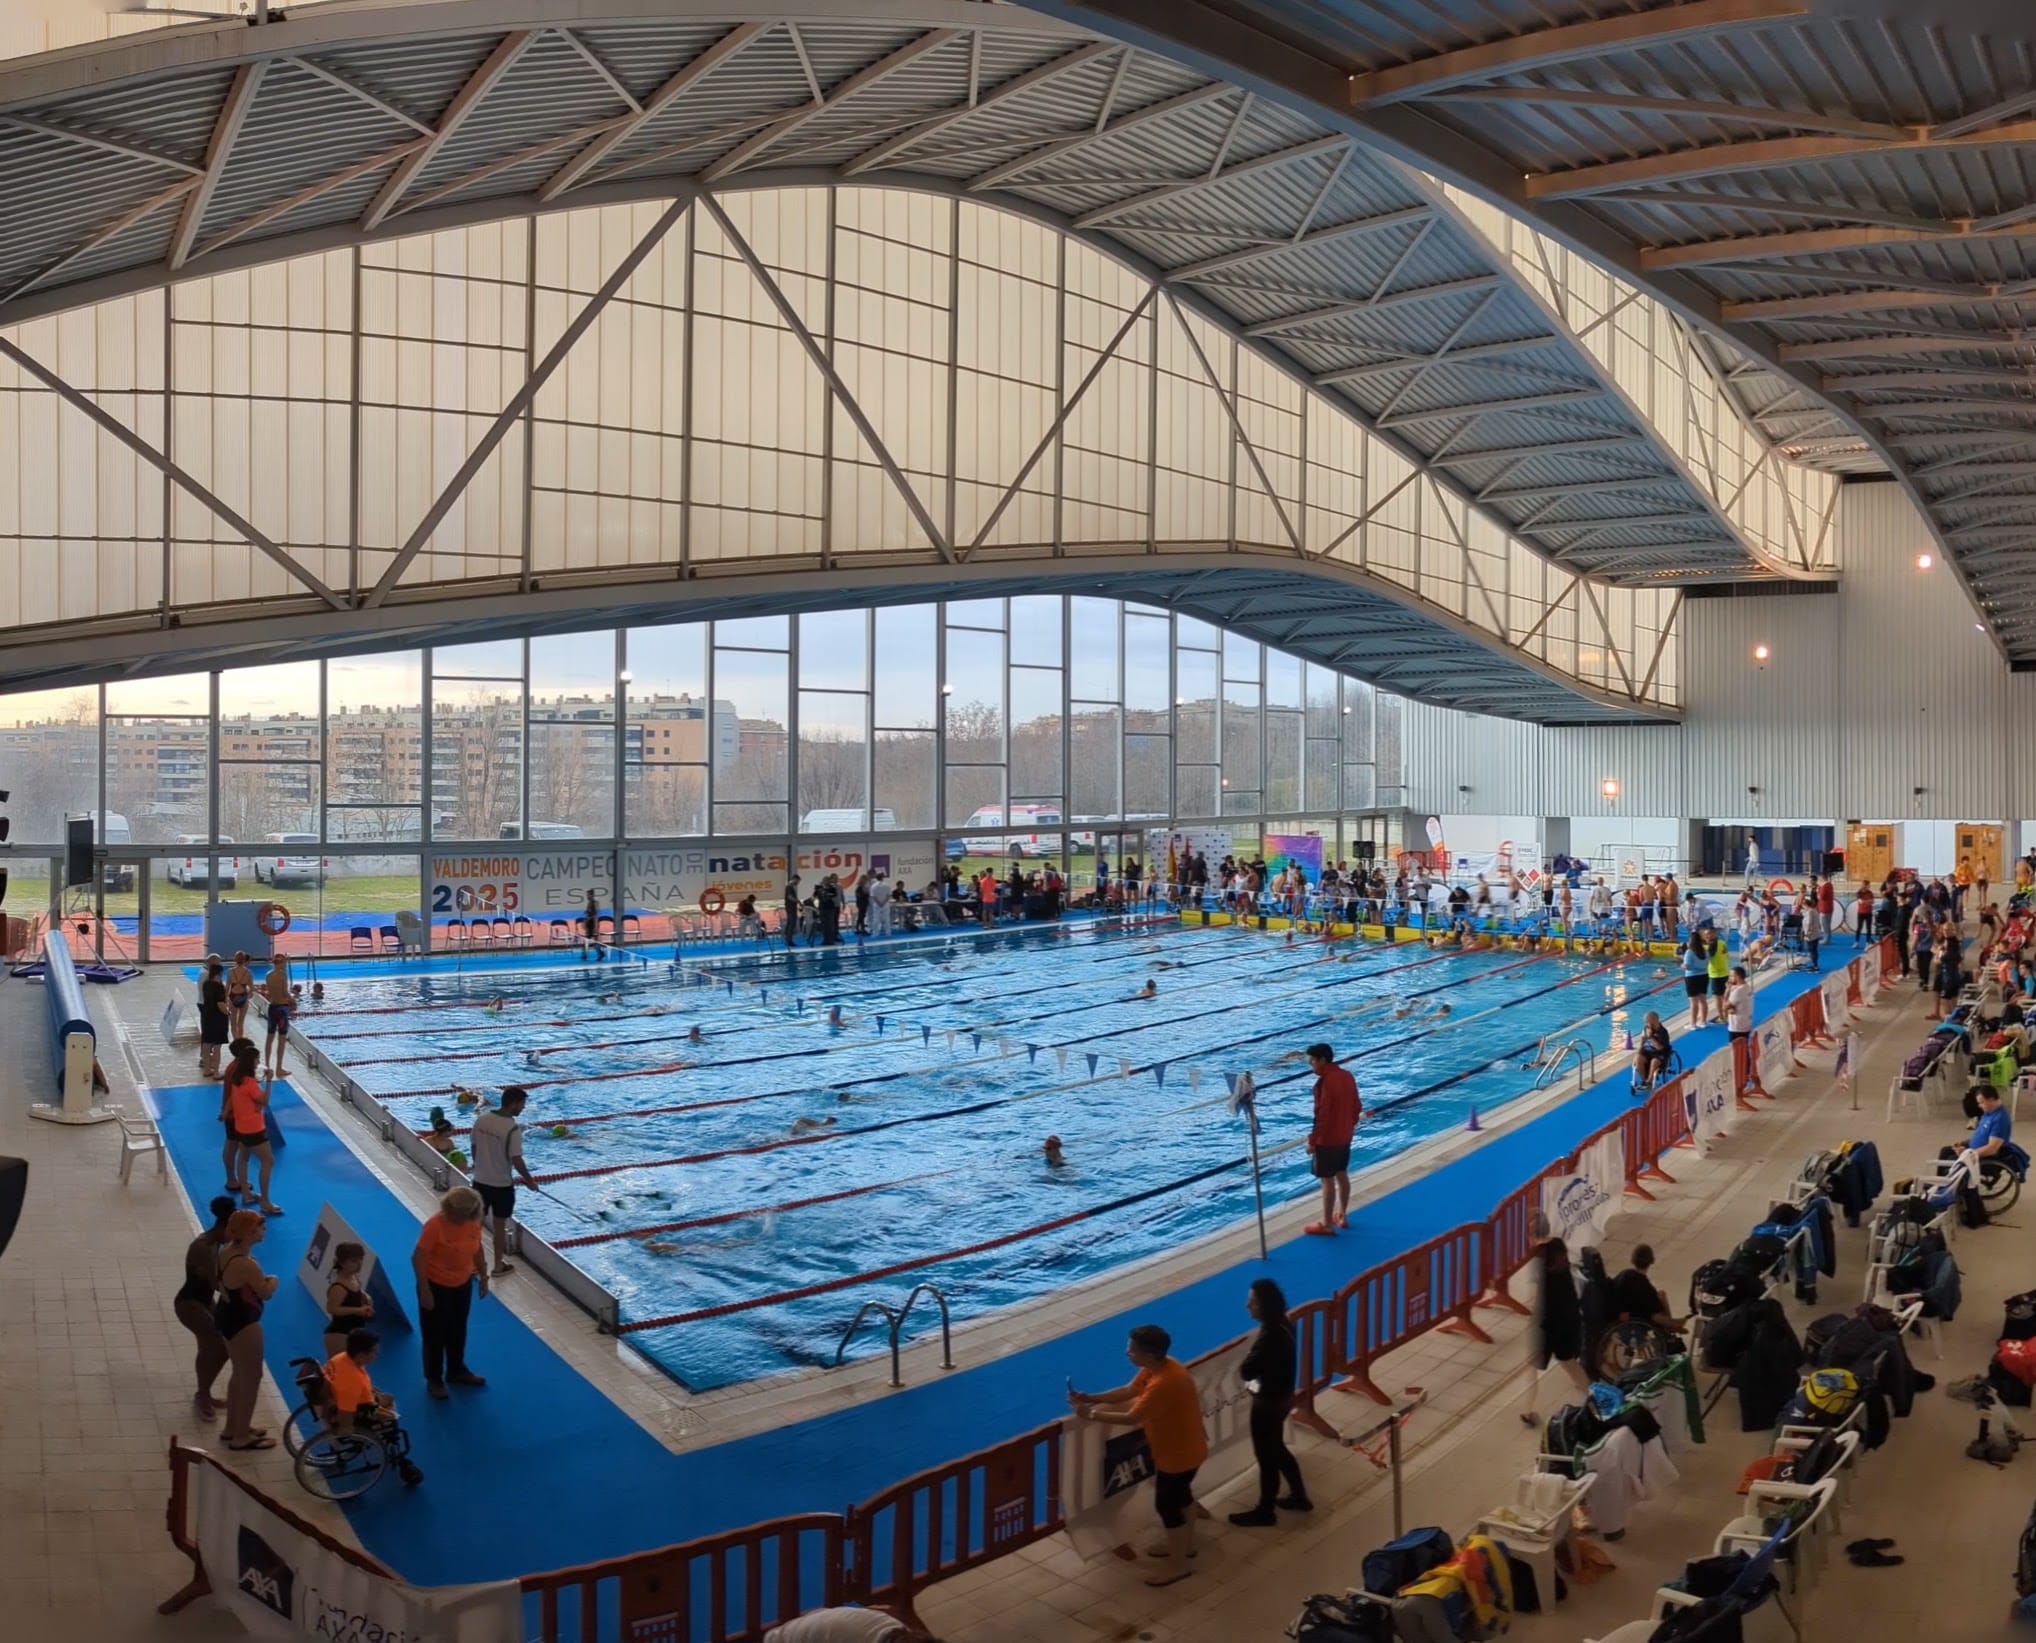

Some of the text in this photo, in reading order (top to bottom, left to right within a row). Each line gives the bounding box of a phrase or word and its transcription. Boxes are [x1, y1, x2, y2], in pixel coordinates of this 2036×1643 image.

[433, 857, 520, 878] VALDEMORO
[686, 853, 703, 874] DE
[708, 848, 862, 873] natación
[432, 883, 519, 912] 2025
[712, 880, 772, 892] jóvenes
[1104, 1453, 1148, 1493] AXA
[239, 1567, 282, 1609] AXA
